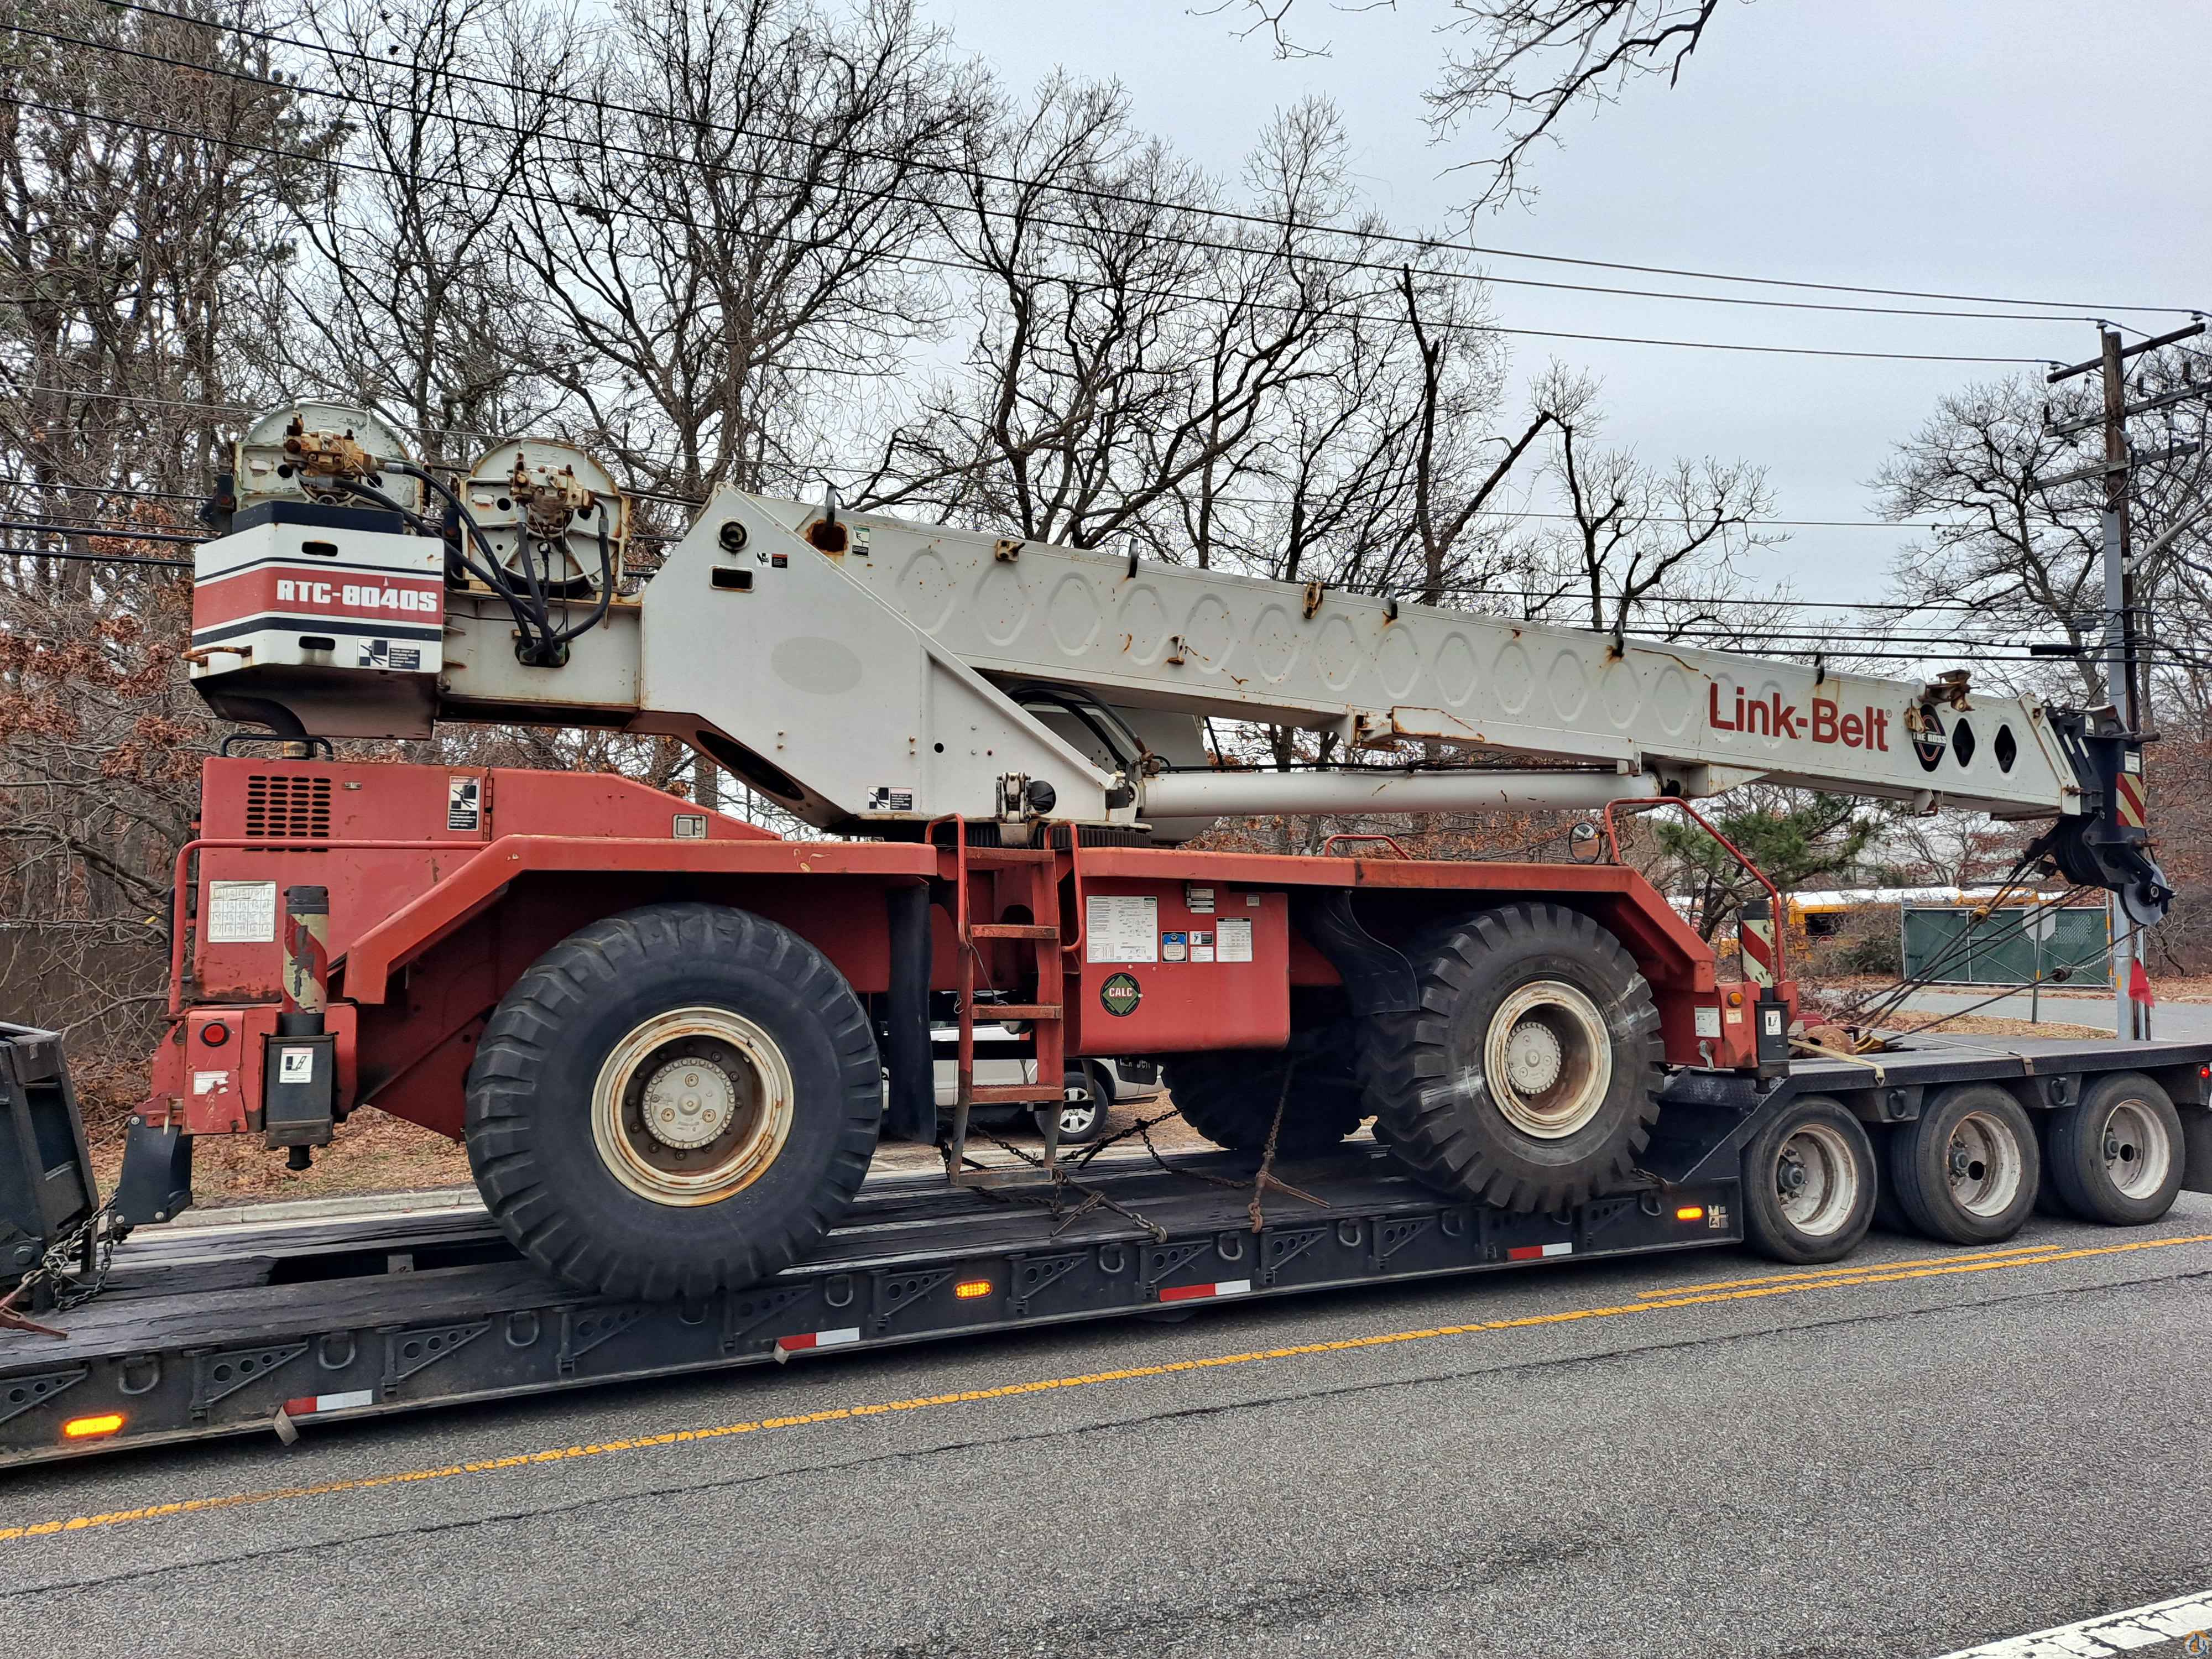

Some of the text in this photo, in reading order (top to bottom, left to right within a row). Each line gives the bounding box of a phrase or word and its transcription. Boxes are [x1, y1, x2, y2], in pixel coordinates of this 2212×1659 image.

[276, 579, 437, 612] RTC-8040S
[1709, 682, 1889, 752] Link-Belt
[1109, 987, 1133, 997] CALC
